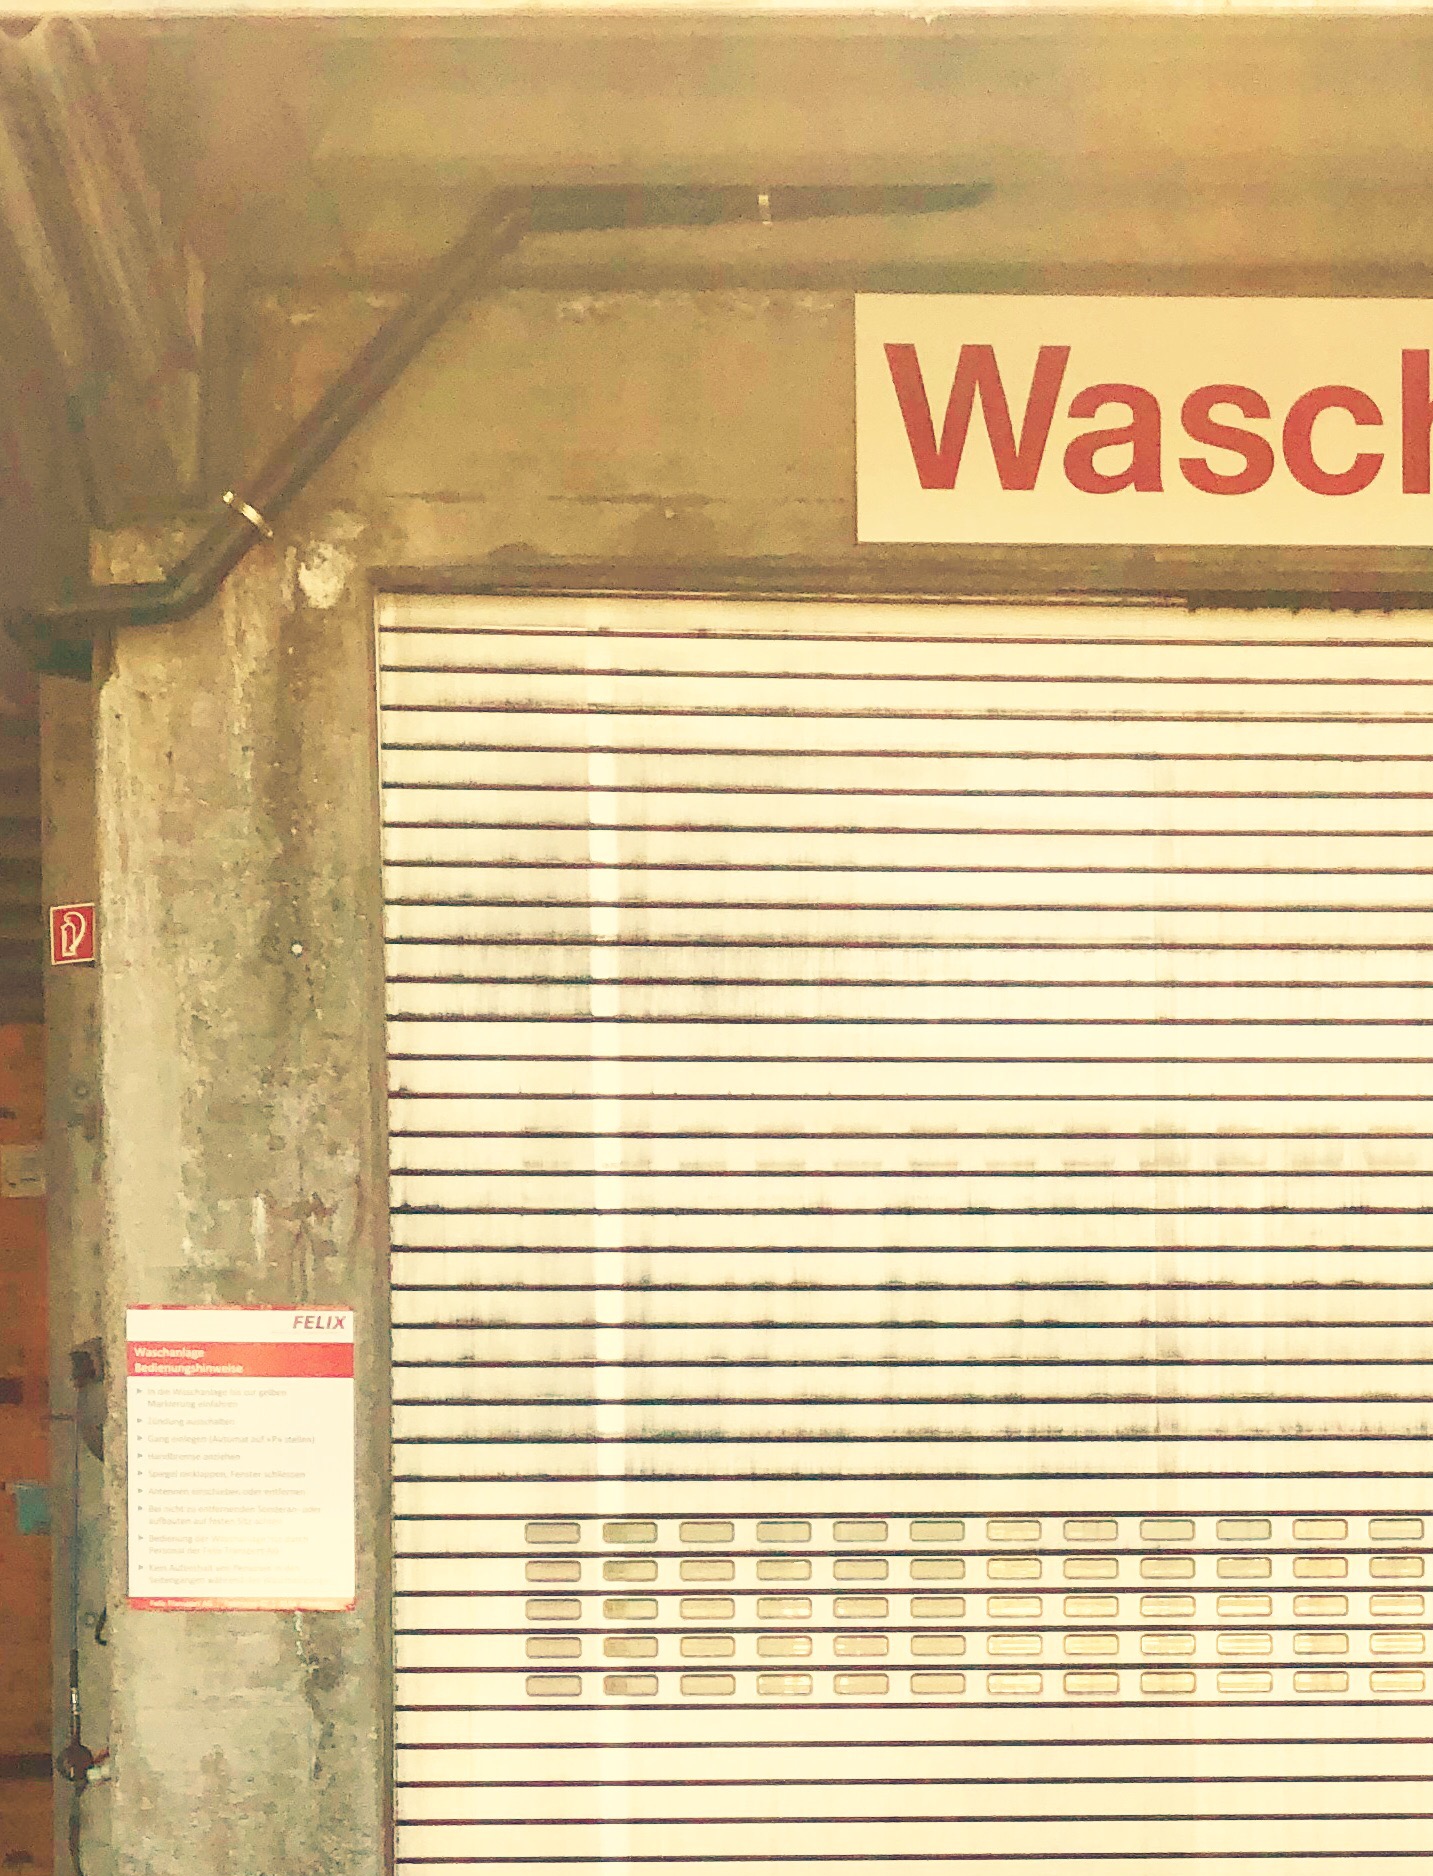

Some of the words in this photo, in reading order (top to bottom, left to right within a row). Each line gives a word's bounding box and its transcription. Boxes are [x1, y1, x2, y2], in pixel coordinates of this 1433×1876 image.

[292, 1315, 346, 1329] FELIX
[134, 1347, 205, 1360] Waschanlage
[134, 1362, 244, 1375] Bedienungshinweise
